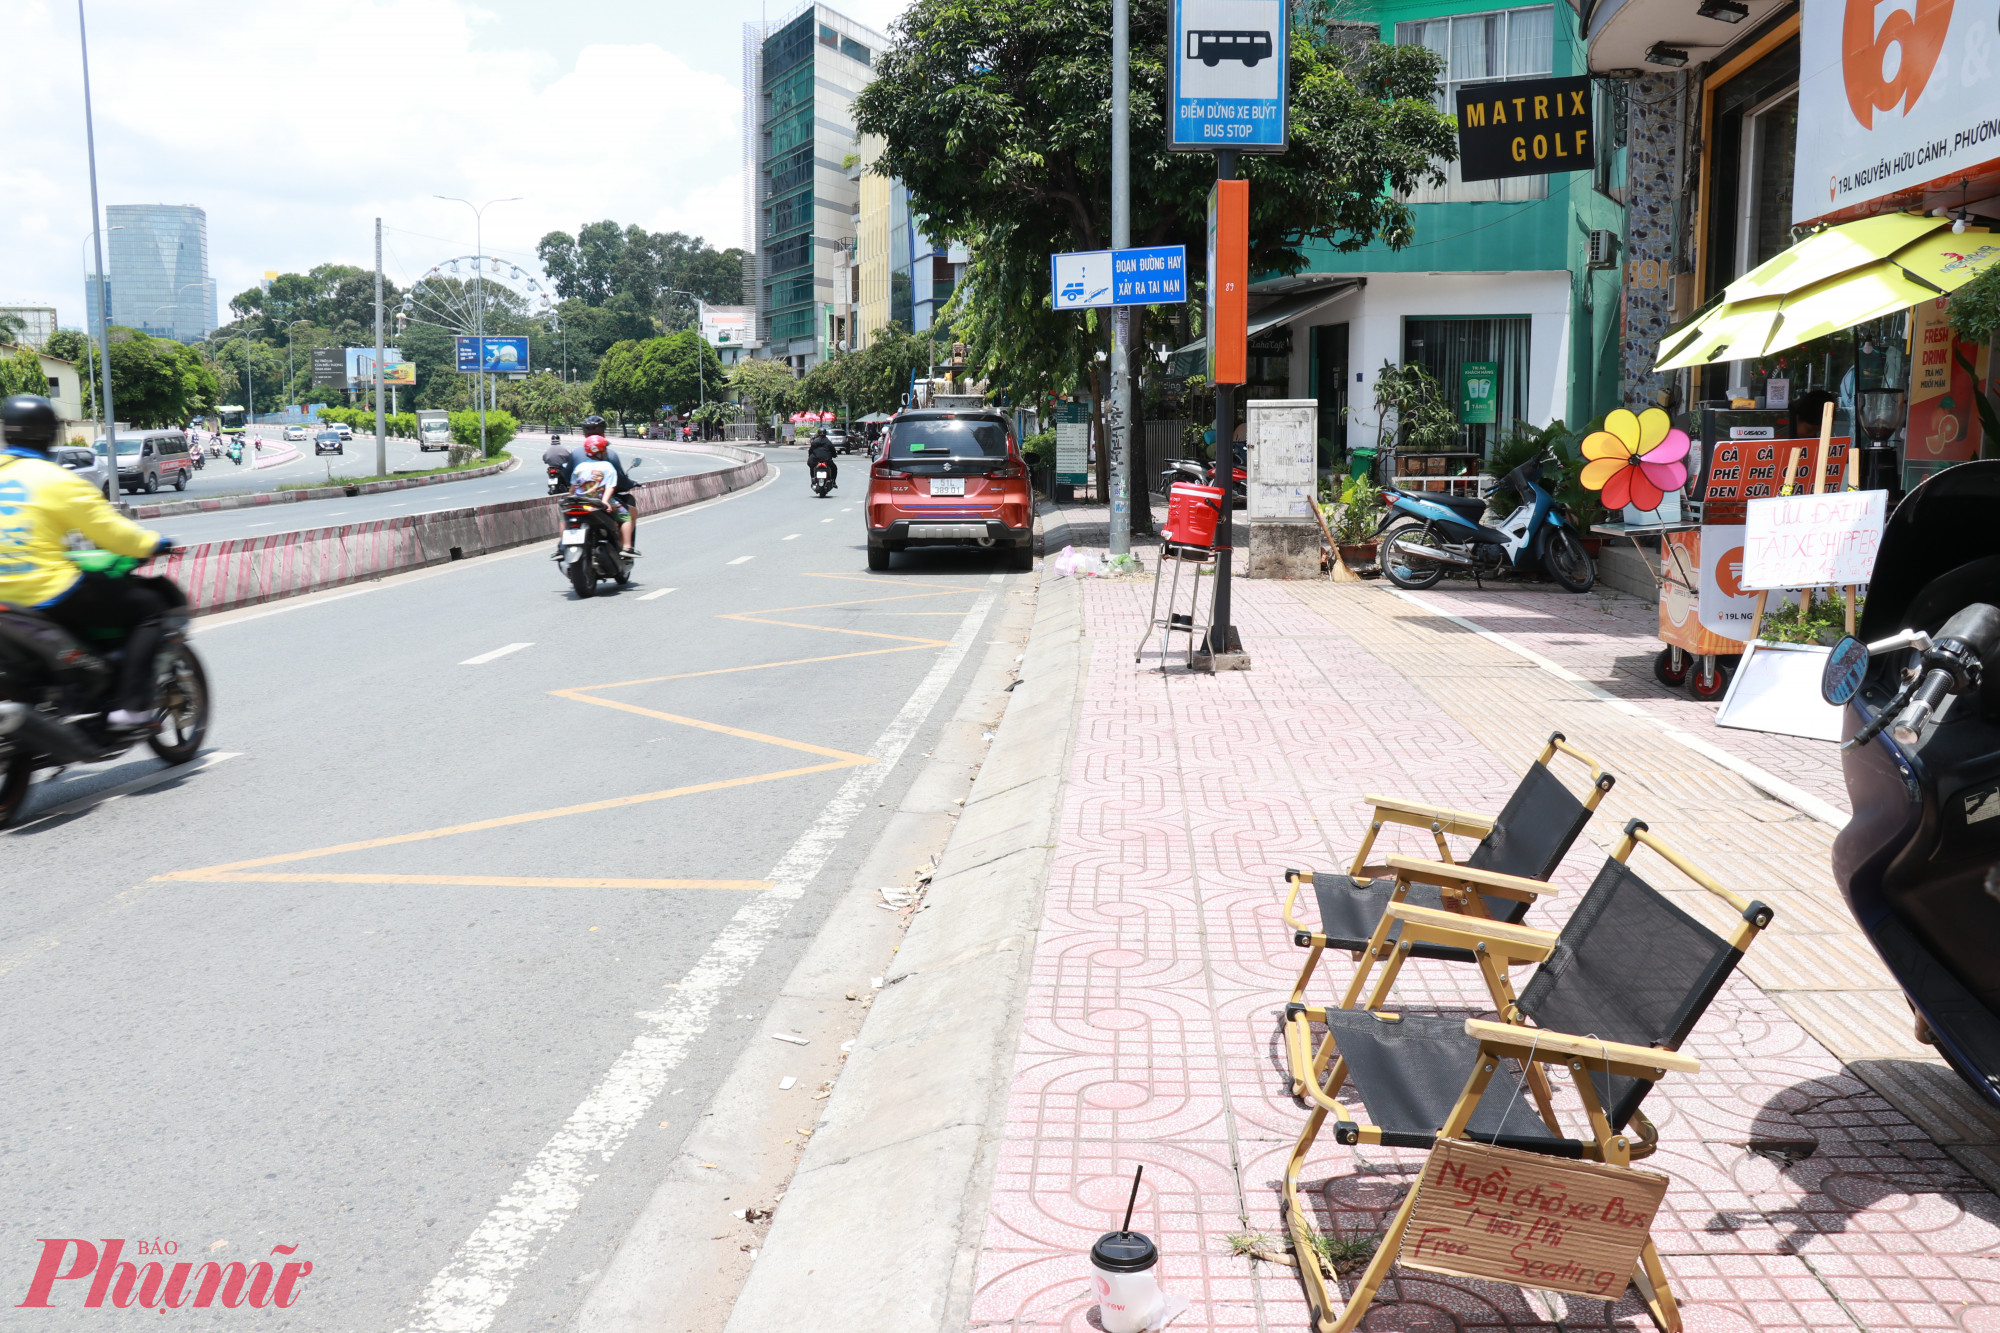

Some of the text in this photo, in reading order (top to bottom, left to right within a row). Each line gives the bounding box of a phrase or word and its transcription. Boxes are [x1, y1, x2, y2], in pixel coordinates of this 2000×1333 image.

[1181, 100, 1277, 119] ĐIỂM DỪNG XE BUÝT
[1467, 91, 1585, 128] MATRIX
[1204, 124, 1253, 138] BUS STOP
[1511, 130, 1587, 162] GOLF
[1838, 176, 1853, 194] 19L
[1854, 158, 1891, 189] NGUYỄN
[1893, 149, 1915, 175] HỮU
[1954, 119, 2000, 151] PHƯỜN
[1116, 254, 1182, 274] ĐOẠN ĐƯỜNG HAY
[1118, 278, 1180, 296] XẢY RA TAI NẠN
[1924, 327, 1948, 344] FRESH
[1922, 349, 1948, 365] DRINK
[1721, 447, 1739, 461] CÀ
[1757, 445, 1774, 460] CÀ
[1712, 465, 1740, 480] PHÊ
[1748, 464, 1775, 479] PHÊ
[1709, 486, 1737, 497] ĐEN
[1744, 483, 1770, 497] SỮA
[1820, 529, 1878, 557] SHIPPER
[1436, 1160, 1512, 1206] Ngồi
[1562, 1200, 1598, 1221] xe
[1600, 1196, 1649, 1228] Bus
[1413, 1227, 1616, 1294] Free Seating
